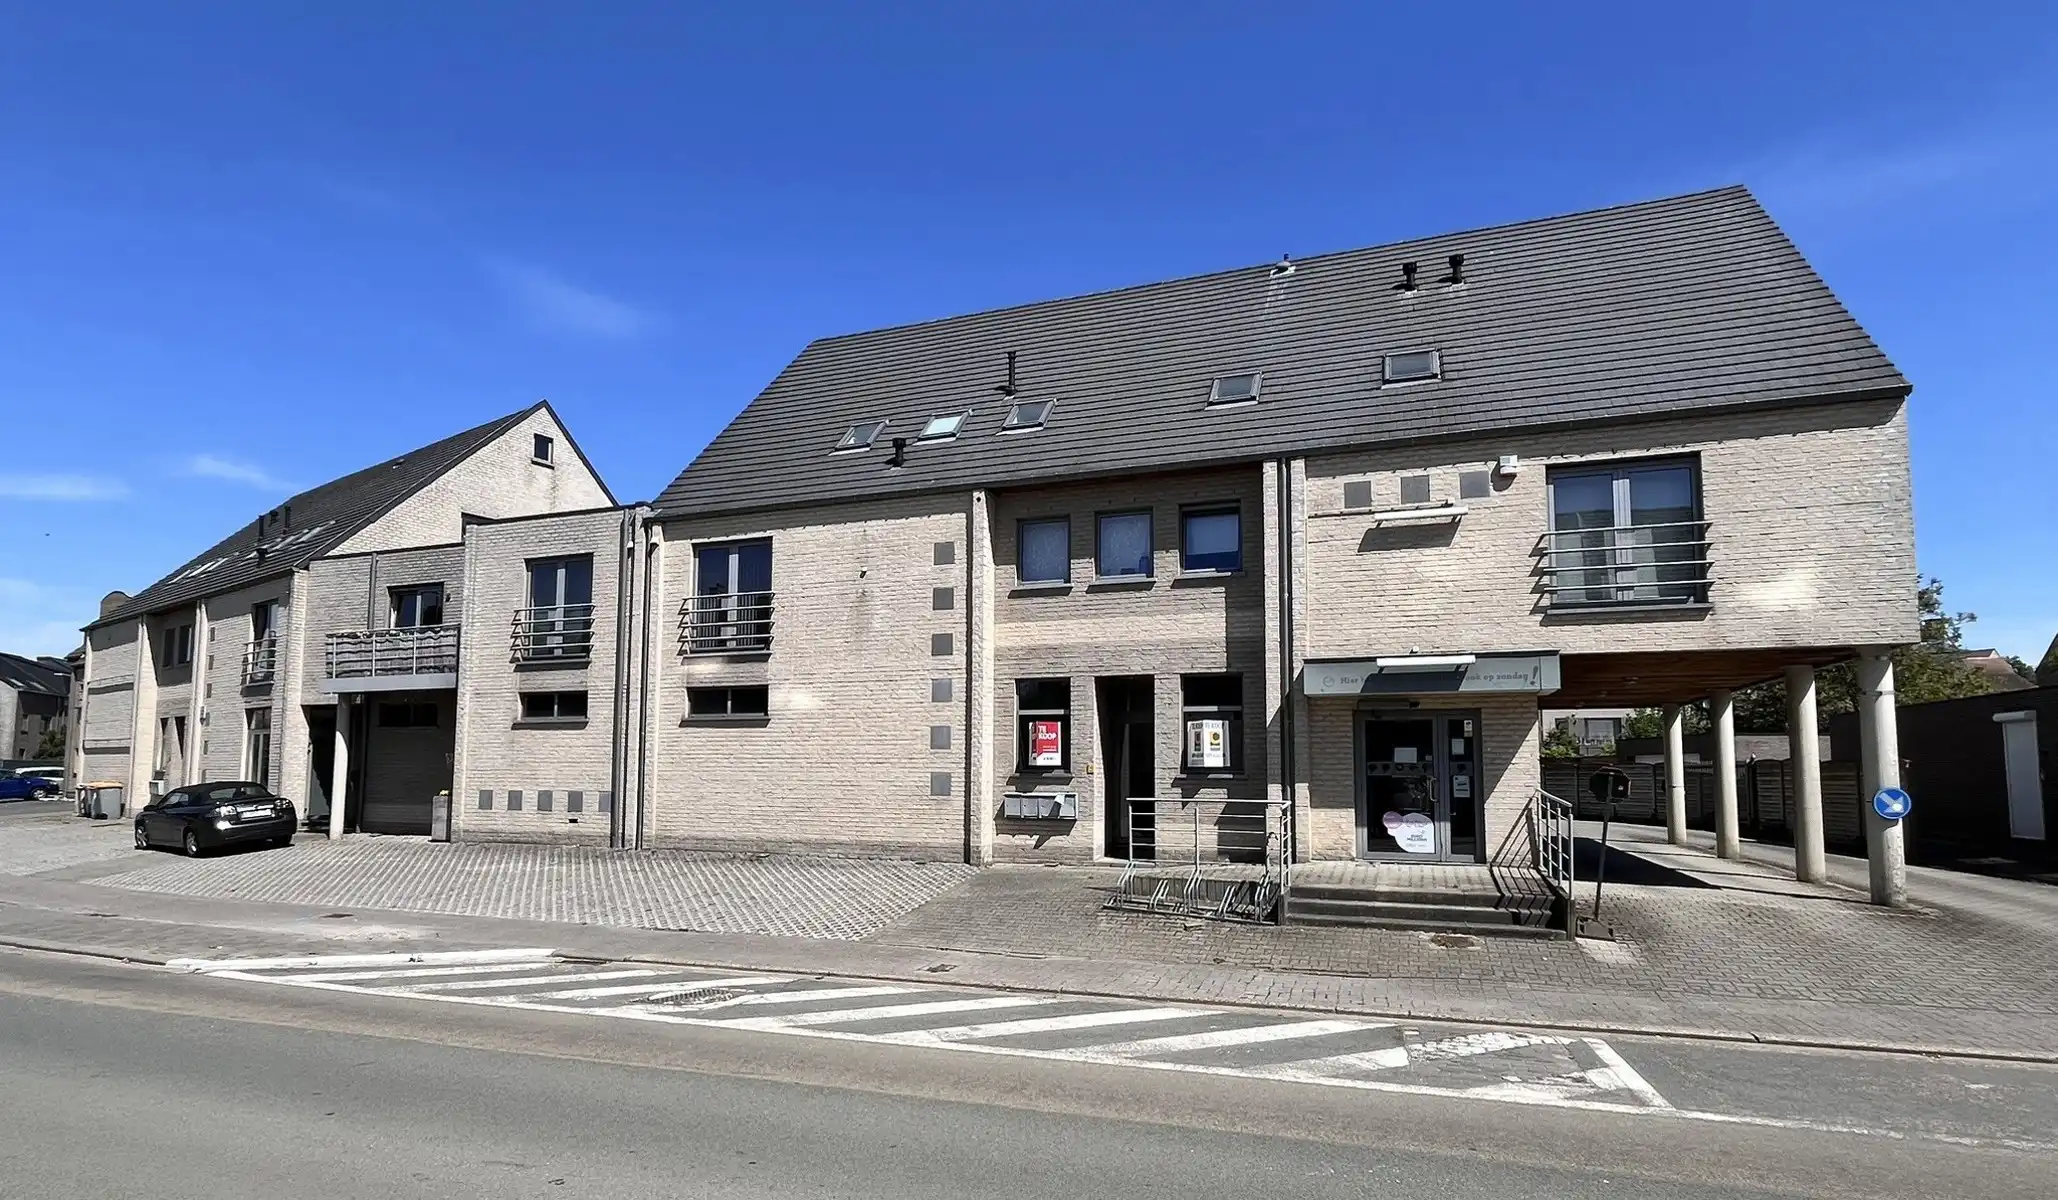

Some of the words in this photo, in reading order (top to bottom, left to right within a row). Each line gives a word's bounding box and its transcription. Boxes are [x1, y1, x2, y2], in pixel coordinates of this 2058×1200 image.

[1340, 676, 1359, 685] Hier
[1483, 674, 1495, 682] op
[1038, 732, 1057, 740] KOOP
